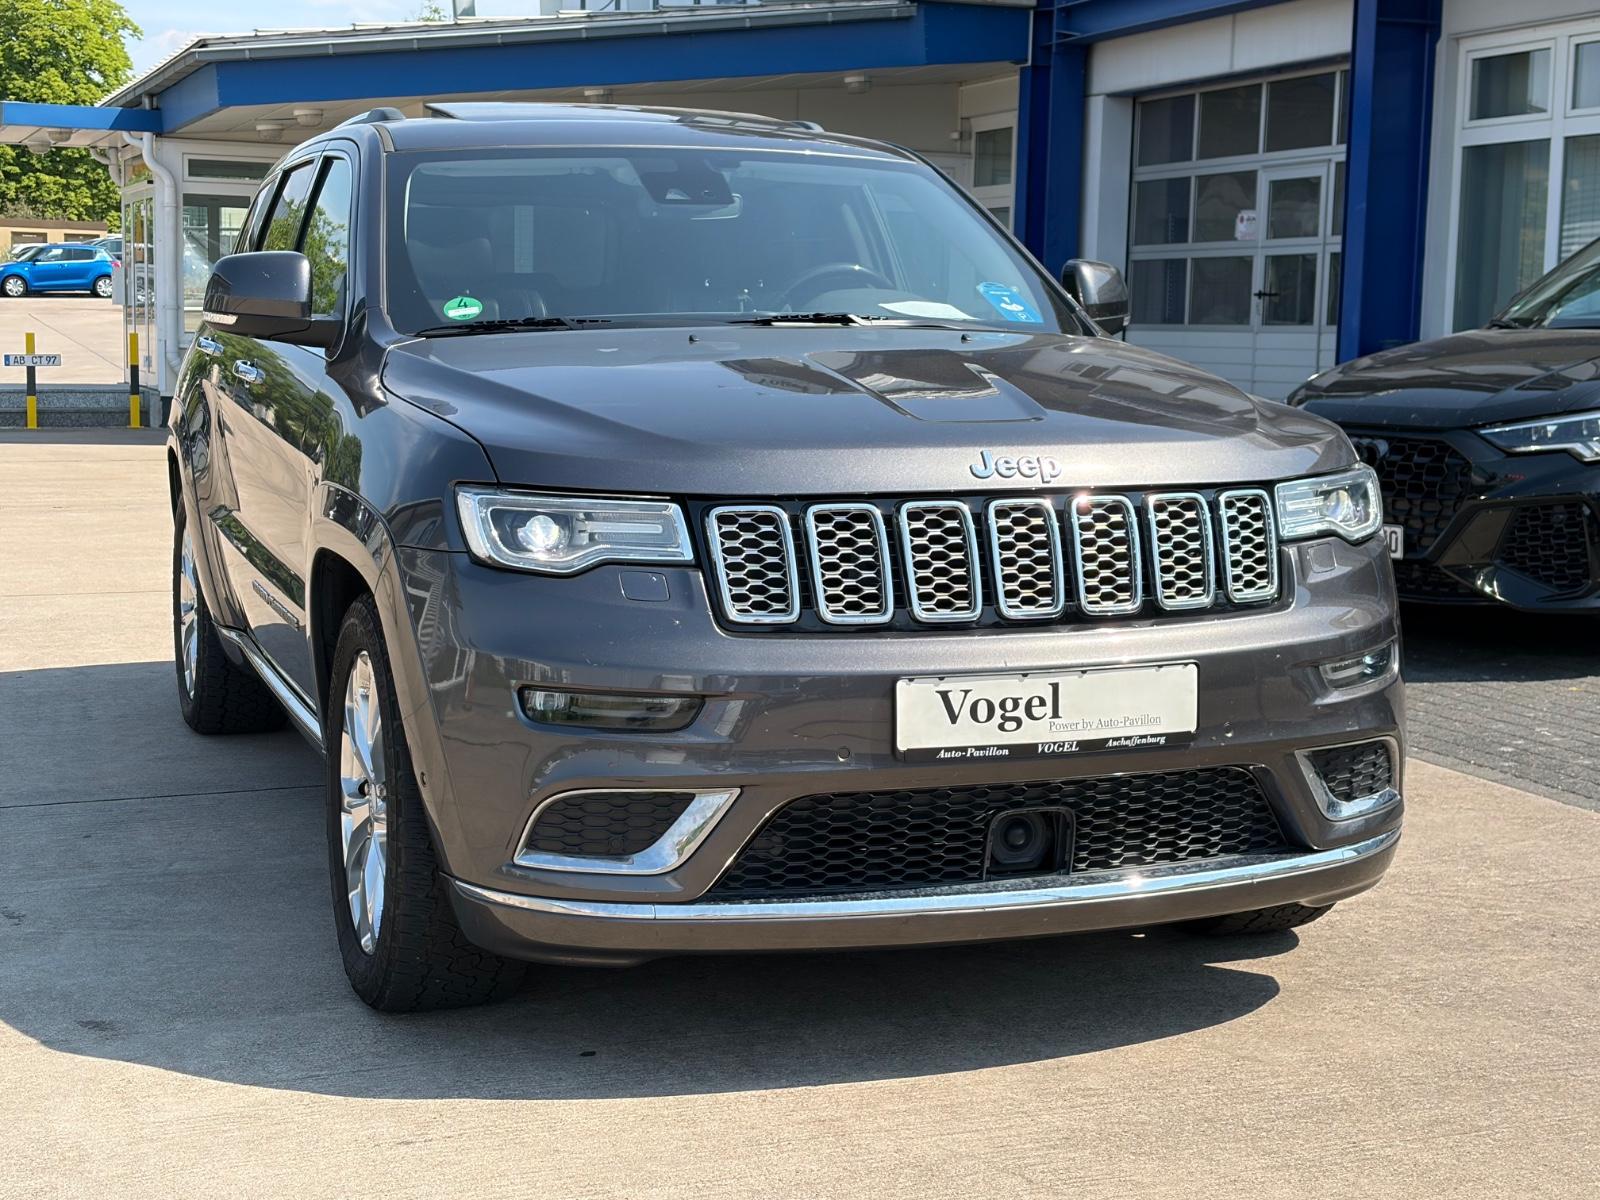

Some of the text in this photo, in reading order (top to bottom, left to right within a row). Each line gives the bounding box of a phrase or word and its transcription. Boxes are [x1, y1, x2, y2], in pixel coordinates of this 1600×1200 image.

[458, 298, 468, 308] 4
[13, 355, 57, 365] AB CT 97
[969, 448, 1062, 484] Jeep
[935, 682, 1063, 732] Vogel
[1048, 714, 1161, 731] Power by Auto-Pavillon
[1106, 735, 1166, 747] Aschaffenburg
[936, 747, 1009, 759] Auto-Pavillon
[1037, 741, 1079, 754] VOGEL
